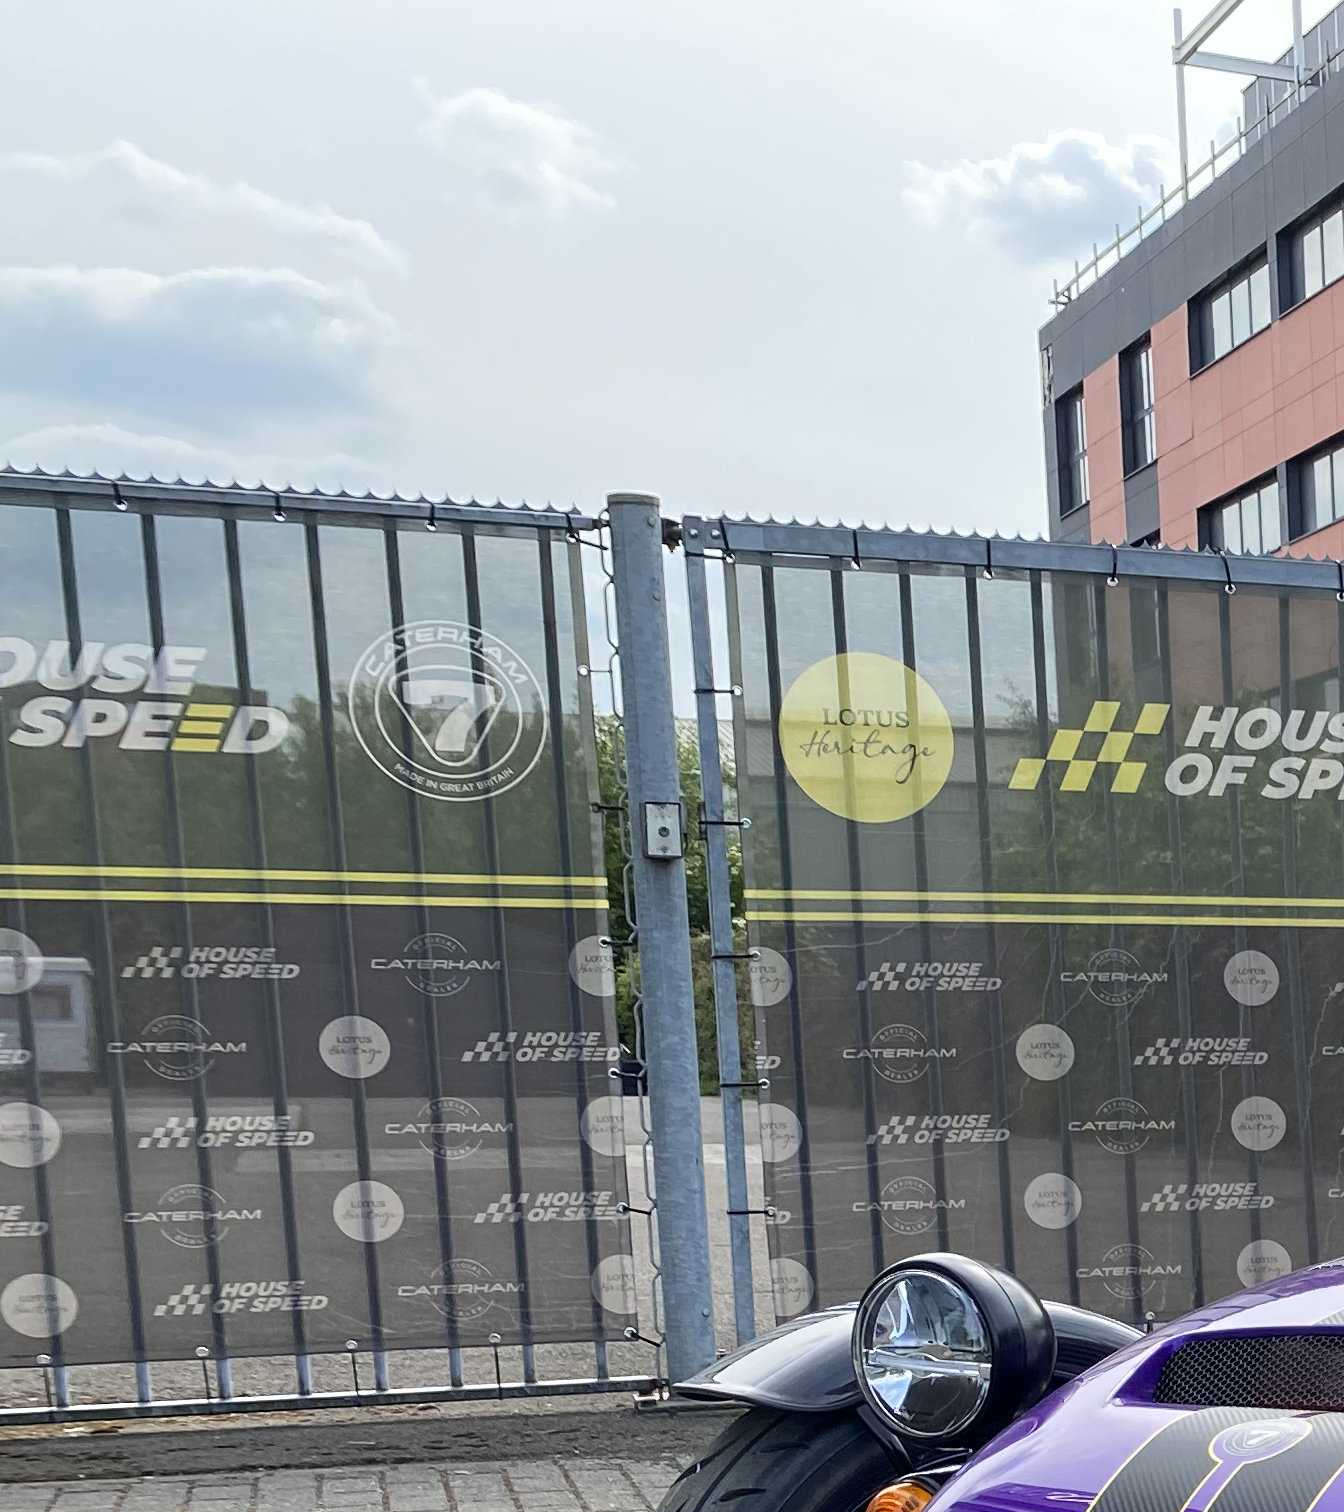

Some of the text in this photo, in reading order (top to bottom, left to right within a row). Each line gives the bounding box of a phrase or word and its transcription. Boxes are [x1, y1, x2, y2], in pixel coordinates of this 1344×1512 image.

[365, 626, 528, 684] CATERHAM
[0, 637, 208, 696] OUSE
[402, 680, 498, 752] 7
[822, 708, 910, 728] LOTUS
[8, 696, 289, 754] SPEED
[800, 729, 936, 784] Heritage
[394, 763, 514, 793] MADE IN GREAT BRITAIN
[1164, 753, 1256, 796] OF
[189, 947, 276, 962] HOUSE
[180, 964, 300, 979] OF SPEED
[370, 958, 501, 971] CATERHAM
[750, 966, 776, 974] OTUS
[912, 962, 983, 977] HOUSE
[905, 977, 1002, 991] OF SPEED
[1060, 972, 1168, 983] CATERHAM
[522, 1031, 601, 1046] HOUSE
[1186, 1038, 1251, 1051] HOUSE
[106, 1042, 247, 1053] CATERHAM
[515, 1047, 621, 1062] OF SPEED
[842, 1048, 957, 1059] CATERHAM
[1178, 1052, 1268, 1065] OF SPEED
[206, 1115, 292, 1131] HOUSE
[385, 1123, 513, 1134] CATERHAM
[761, 1122, 787, 1130] OTUS
[921, 1114, 991, 1129] HOUSE
[1068, 1120, 1175, 1131] CATERHAM
[197, 1131, 314, 1148] OF SPEED
[914, 1129, 1010, 1143] OF SPEED
[1191, 1182, 1257, 1196] HOUSE
[535, 1191, 613, 1207] HOUSE
[852, 1200, 966, 1212] CATERHAM
[1185, 1196, 1275, 1211] OF SPEED
[124, 1209, 262, 1223] CATERHAM
[527, 1208, 561, 1222] OF
[1076, 1265, 1181, 1278] CATERHAM
[773, 1276, 799, 1284] OTUS
[220, 1281, 305, 1297] HOUSE
[397, 1283, 524, 1296] CATERHAM
[212, 1295, 329, 1314] OF SPEED
